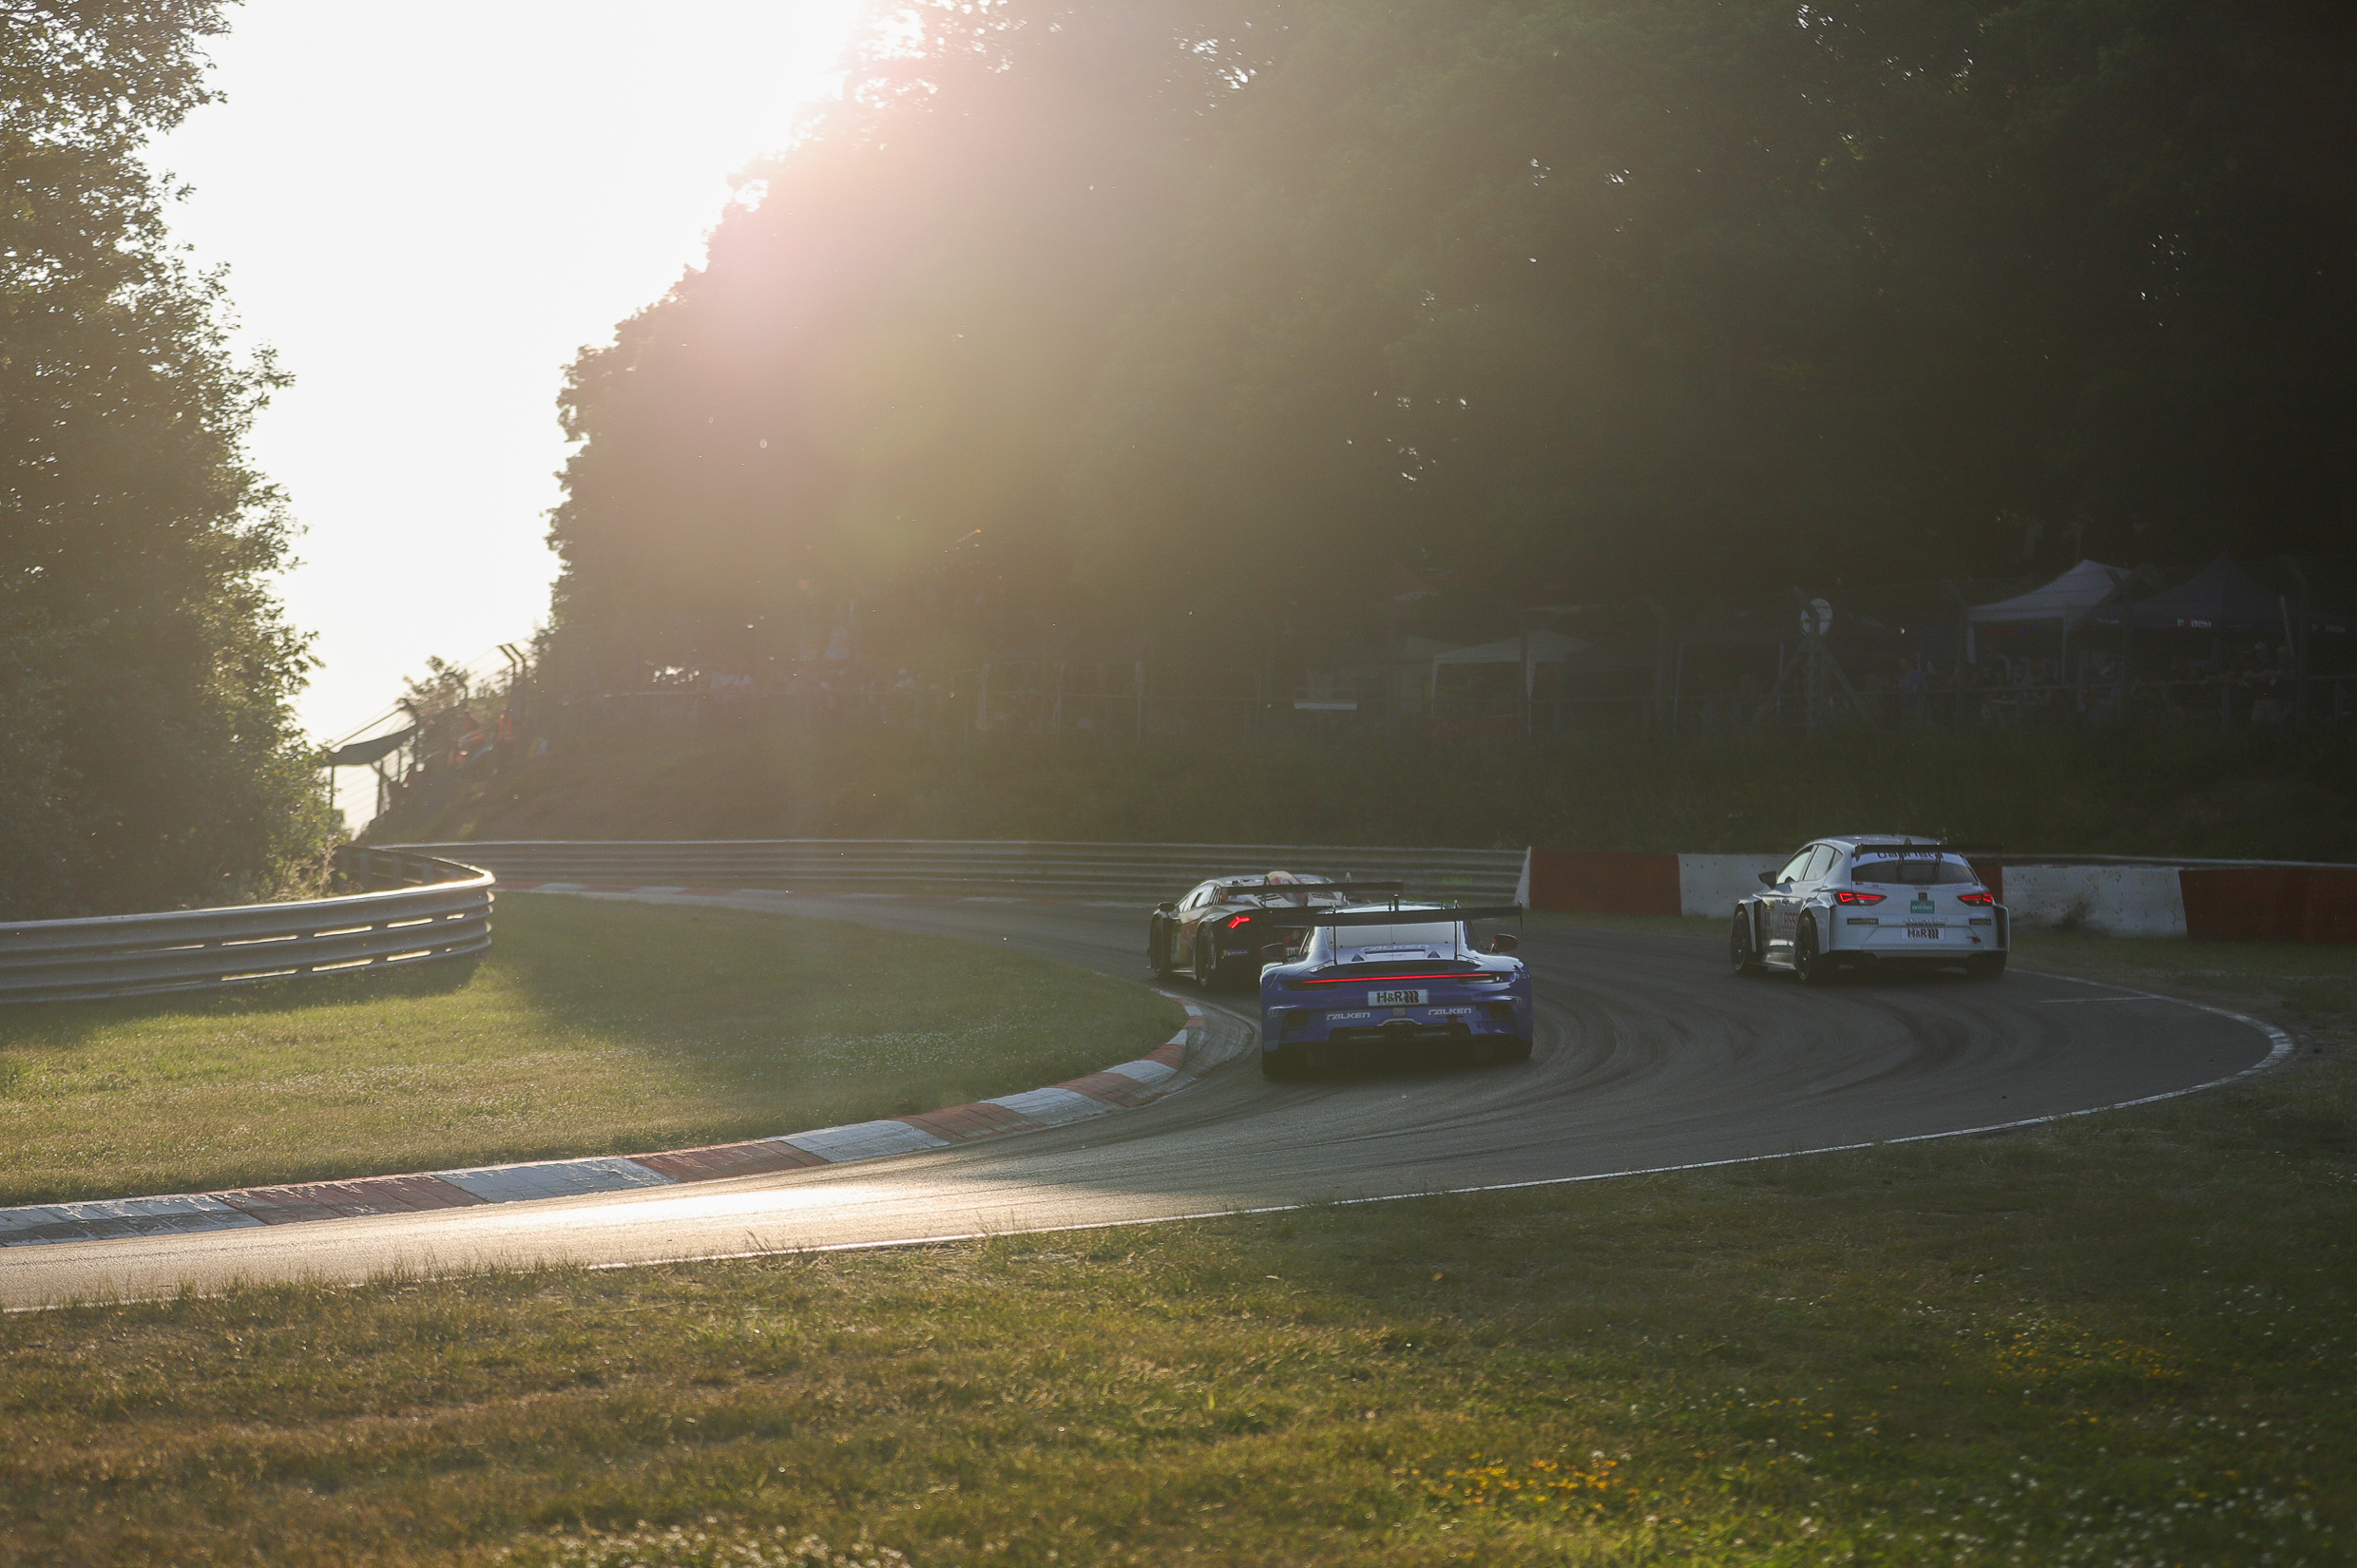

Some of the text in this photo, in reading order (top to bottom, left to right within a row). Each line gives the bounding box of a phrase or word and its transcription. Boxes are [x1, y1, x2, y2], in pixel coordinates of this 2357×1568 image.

[1377, 991, 1404, 1004] H&R
[1326, 1011, 1371, 1021] FALKEN
[1428, 1007, 1472, 1016] FALKEN
